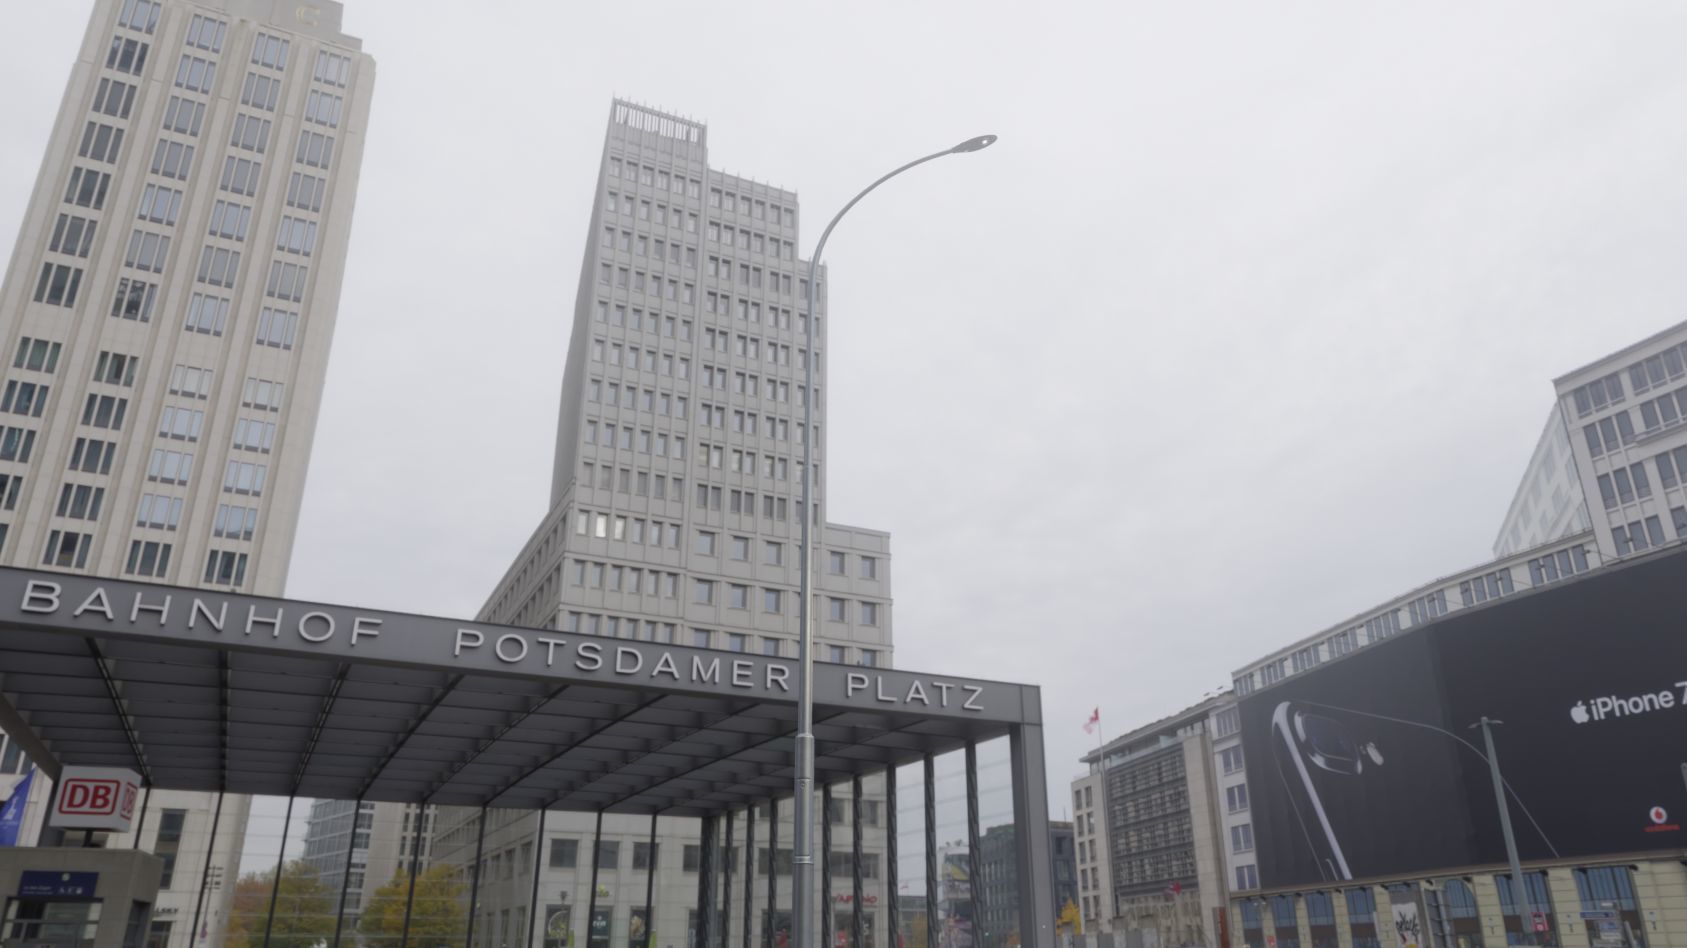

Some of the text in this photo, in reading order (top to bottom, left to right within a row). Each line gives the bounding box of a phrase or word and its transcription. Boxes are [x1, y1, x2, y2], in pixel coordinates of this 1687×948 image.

[20, 579, 985, 711] BAHNHOF POTSDAMER PLATZ
[1590, 690, 1675, 721] iPhone
[66, 783, 111, 809] DB
